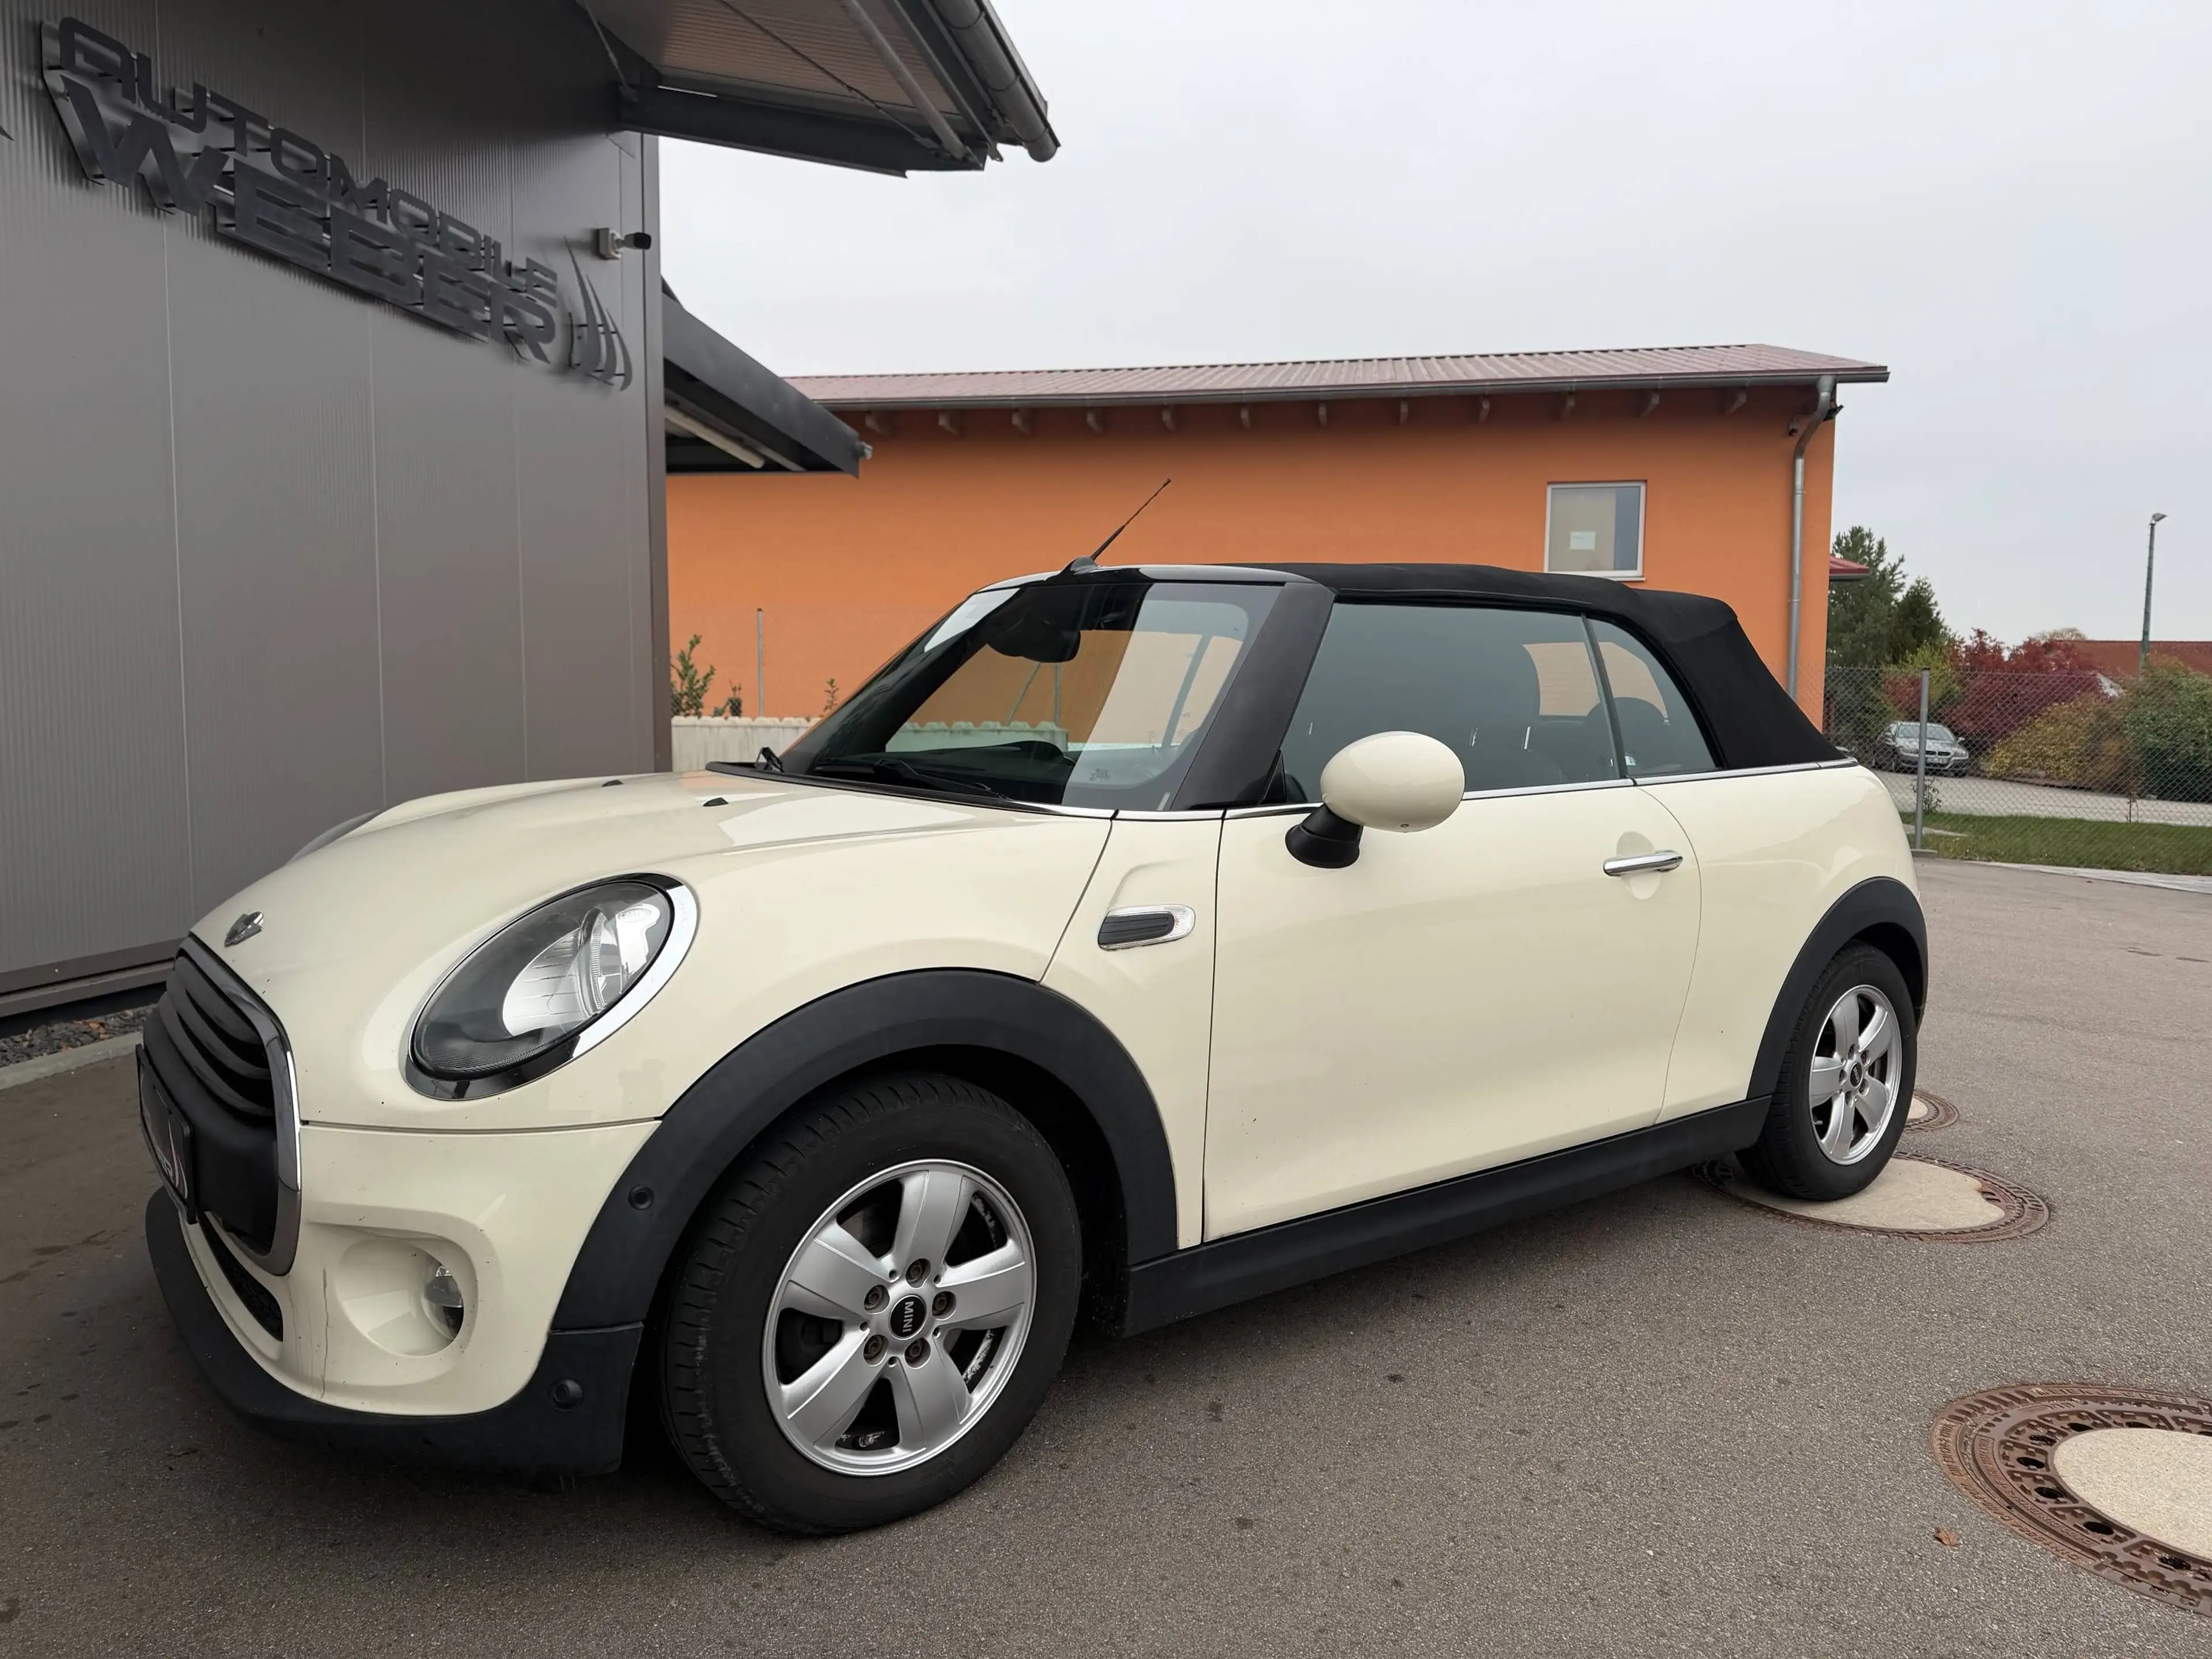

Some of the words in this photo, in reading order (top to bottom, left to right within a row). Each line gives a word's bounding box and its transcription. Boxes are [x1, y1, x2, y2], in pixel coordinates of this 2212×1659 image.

[59, 16, 558, 309] AUTOMOBILE
[60, 74, 557, 364] WEBER
[903, 1301, 914, 1333] MINI
